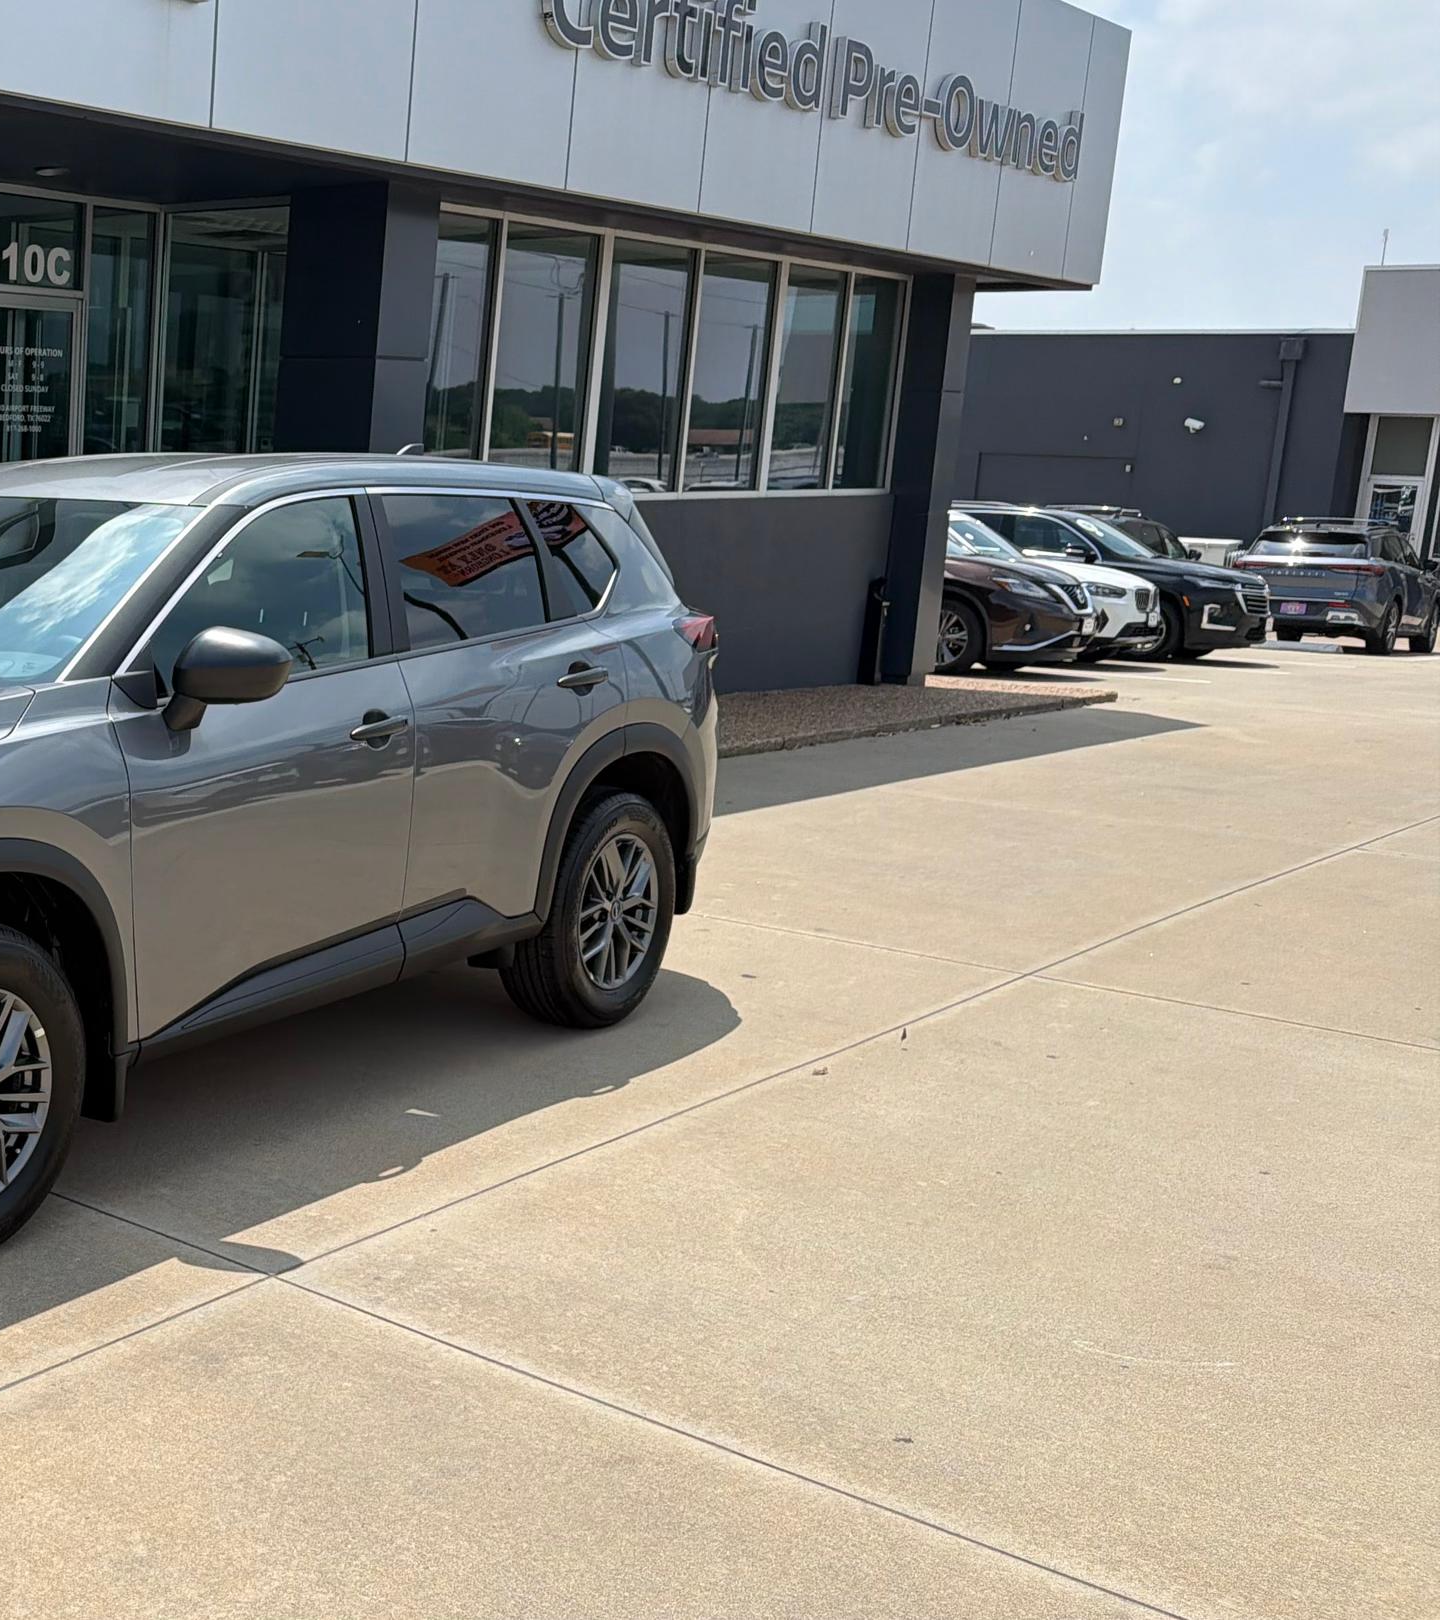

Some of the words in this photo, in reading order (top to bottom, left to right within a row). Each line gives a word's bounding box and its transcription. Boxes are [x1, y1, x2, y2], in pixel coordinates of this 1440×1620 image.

[832, 36, 1085, 182] Pre-Owned
[14, 347, 24, 355] OF
[25, 347, 63, 358] OPERATION
[1, 384, 24, 392] CLOSED
[25, 385, 49, 393] SUNDAY
[30, 405, 55, 413] FREEWAY
